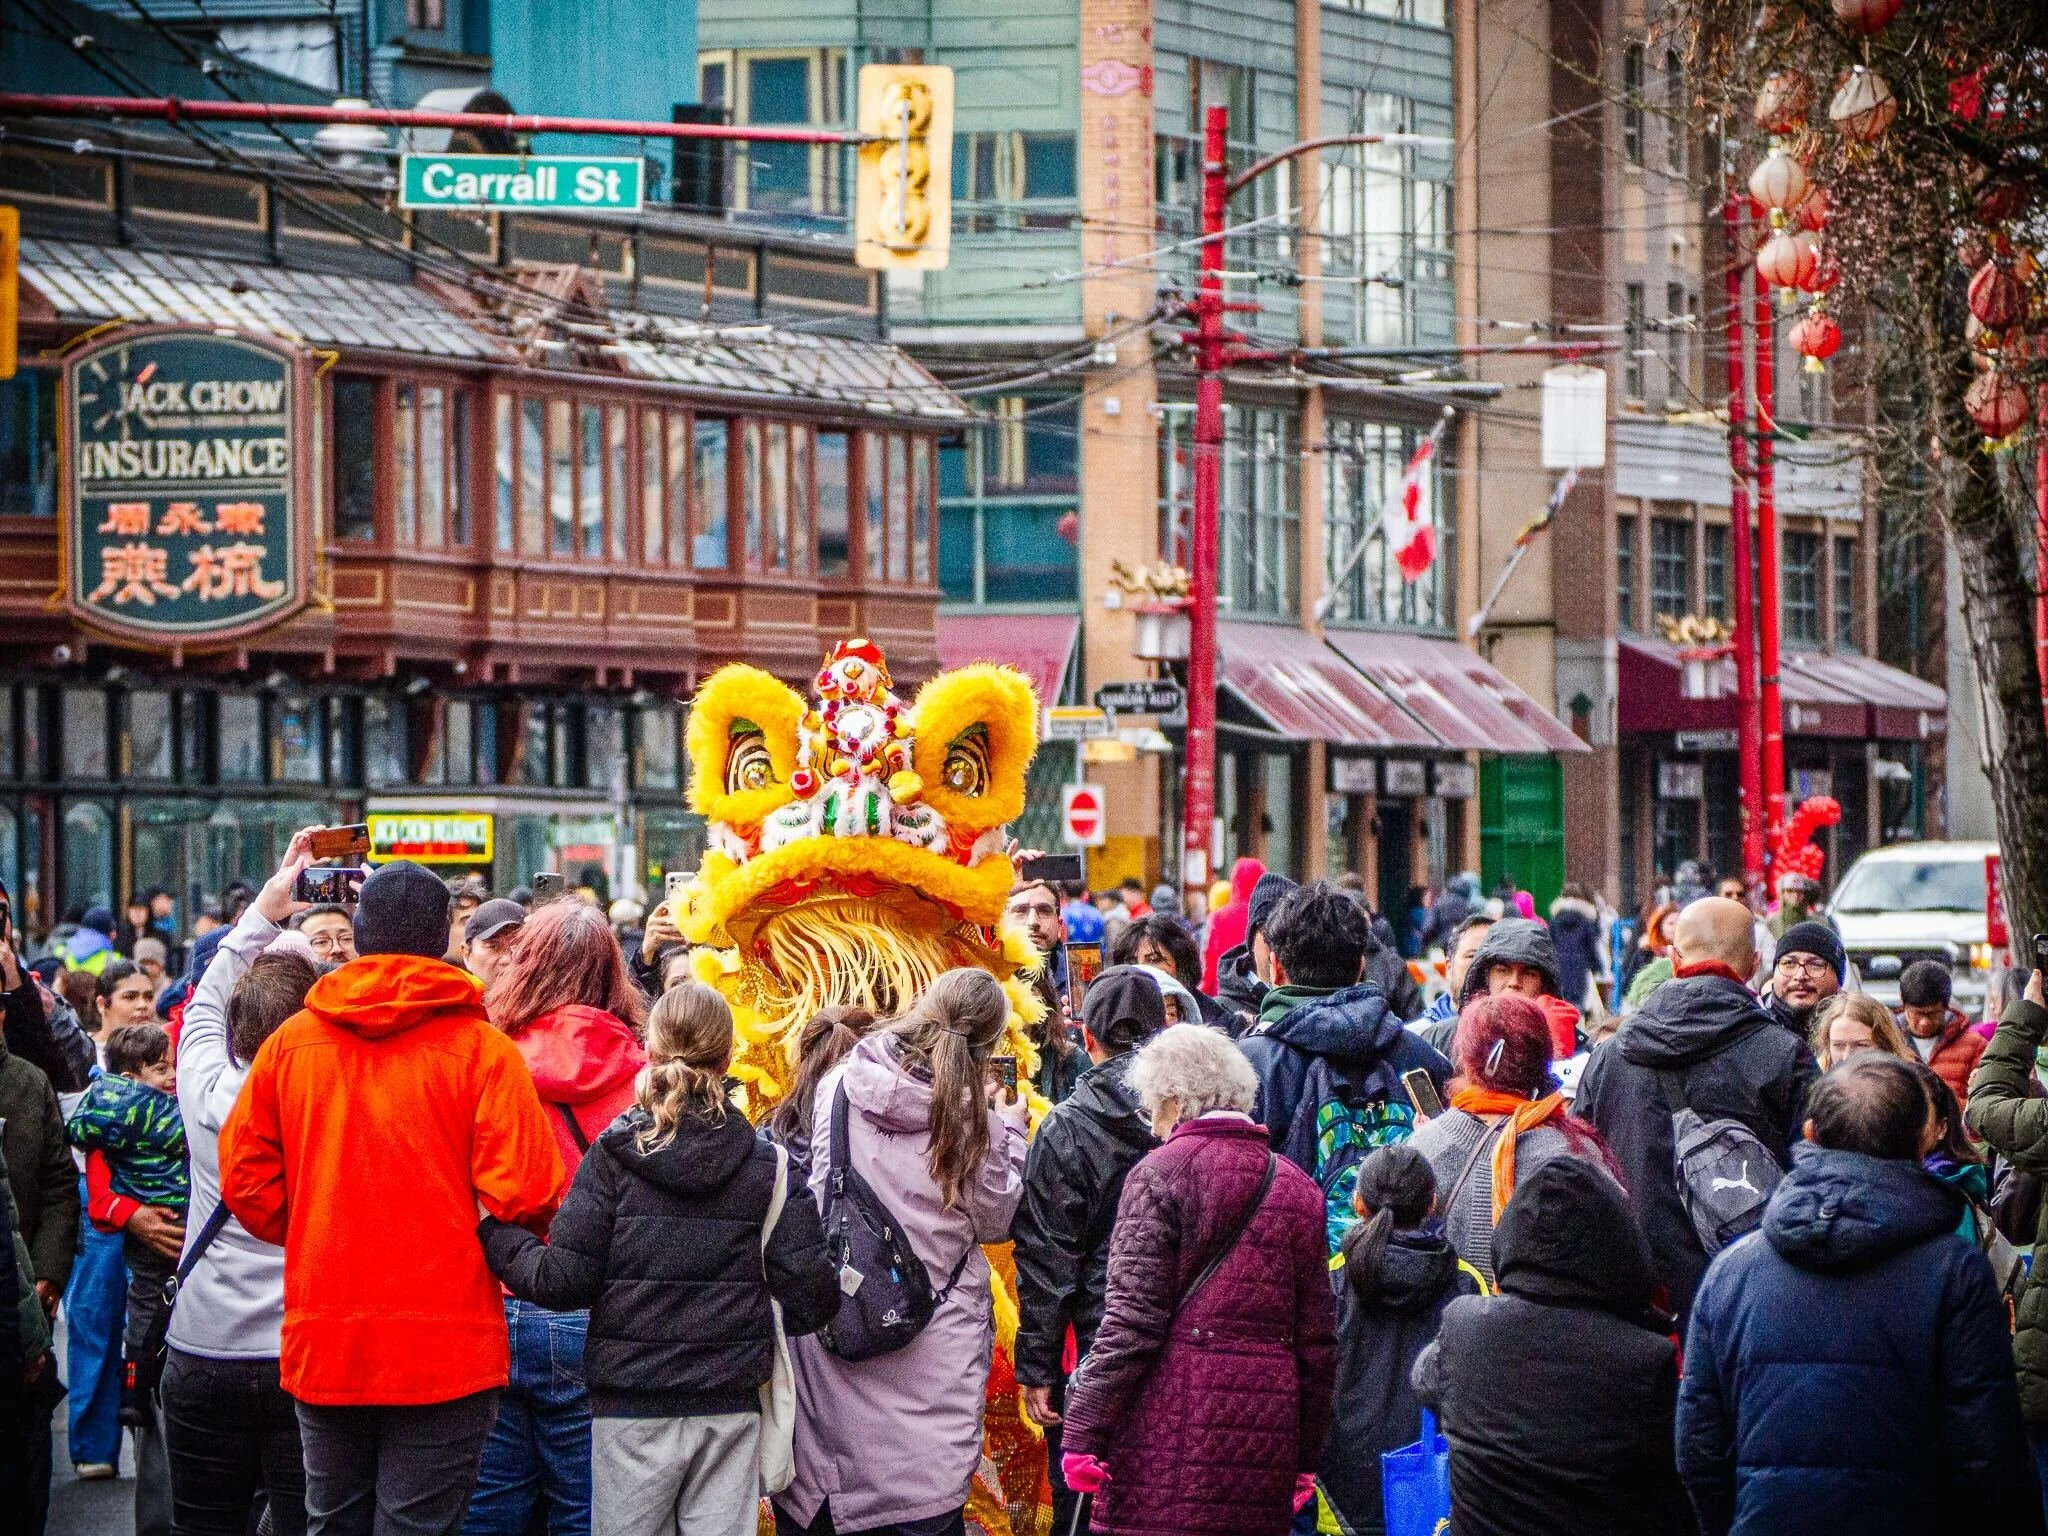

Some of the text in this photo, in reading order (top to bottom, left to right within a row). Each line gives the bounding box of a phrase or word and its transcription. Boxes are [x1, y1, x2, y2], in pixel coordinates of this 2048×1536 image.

[421, 162, 622, 204] Carrall St
[116, 379, 285, 418] JACK CHOW
[80, 437, 288, 480] INSURANCE
